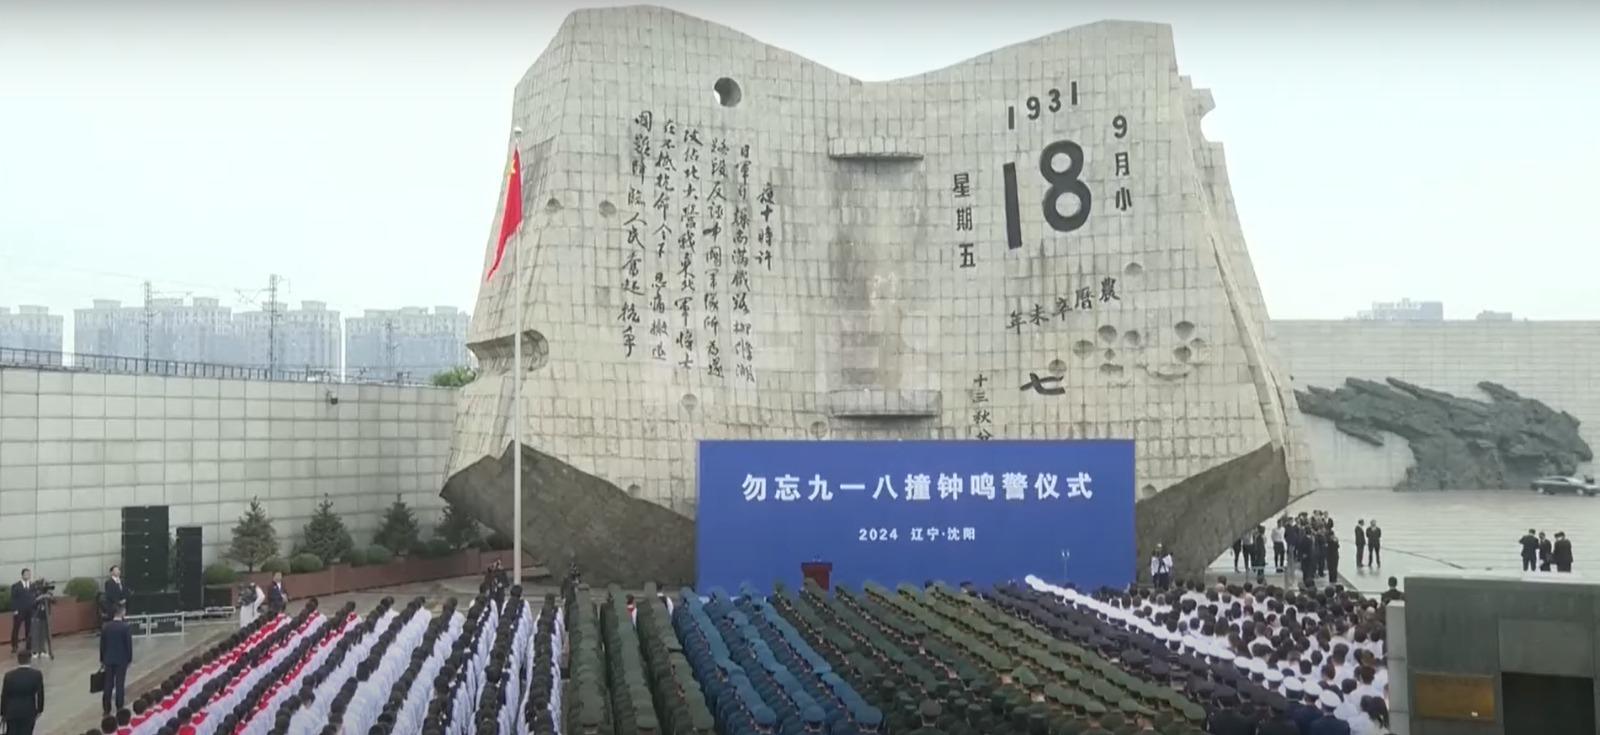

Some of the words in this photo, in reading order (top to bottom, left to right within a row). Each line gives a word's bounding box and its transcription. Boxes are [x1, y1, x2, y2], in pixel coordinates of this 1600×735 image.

[1008, 81, 1078, 130] 1931
[1112, 115, 1132, 211] 9月小
[1003, 140, 1092, 250] 18
[953, 172, 976, 268] 星期五
[1020, 373, 1066, 395] 七
[742, 472, 1092, 501] 勿忘九一八撞钟鸣警仪式
[859, 528, 898, 541] 2024
[911, 527, 976, 541] 辽宁·沈阳
